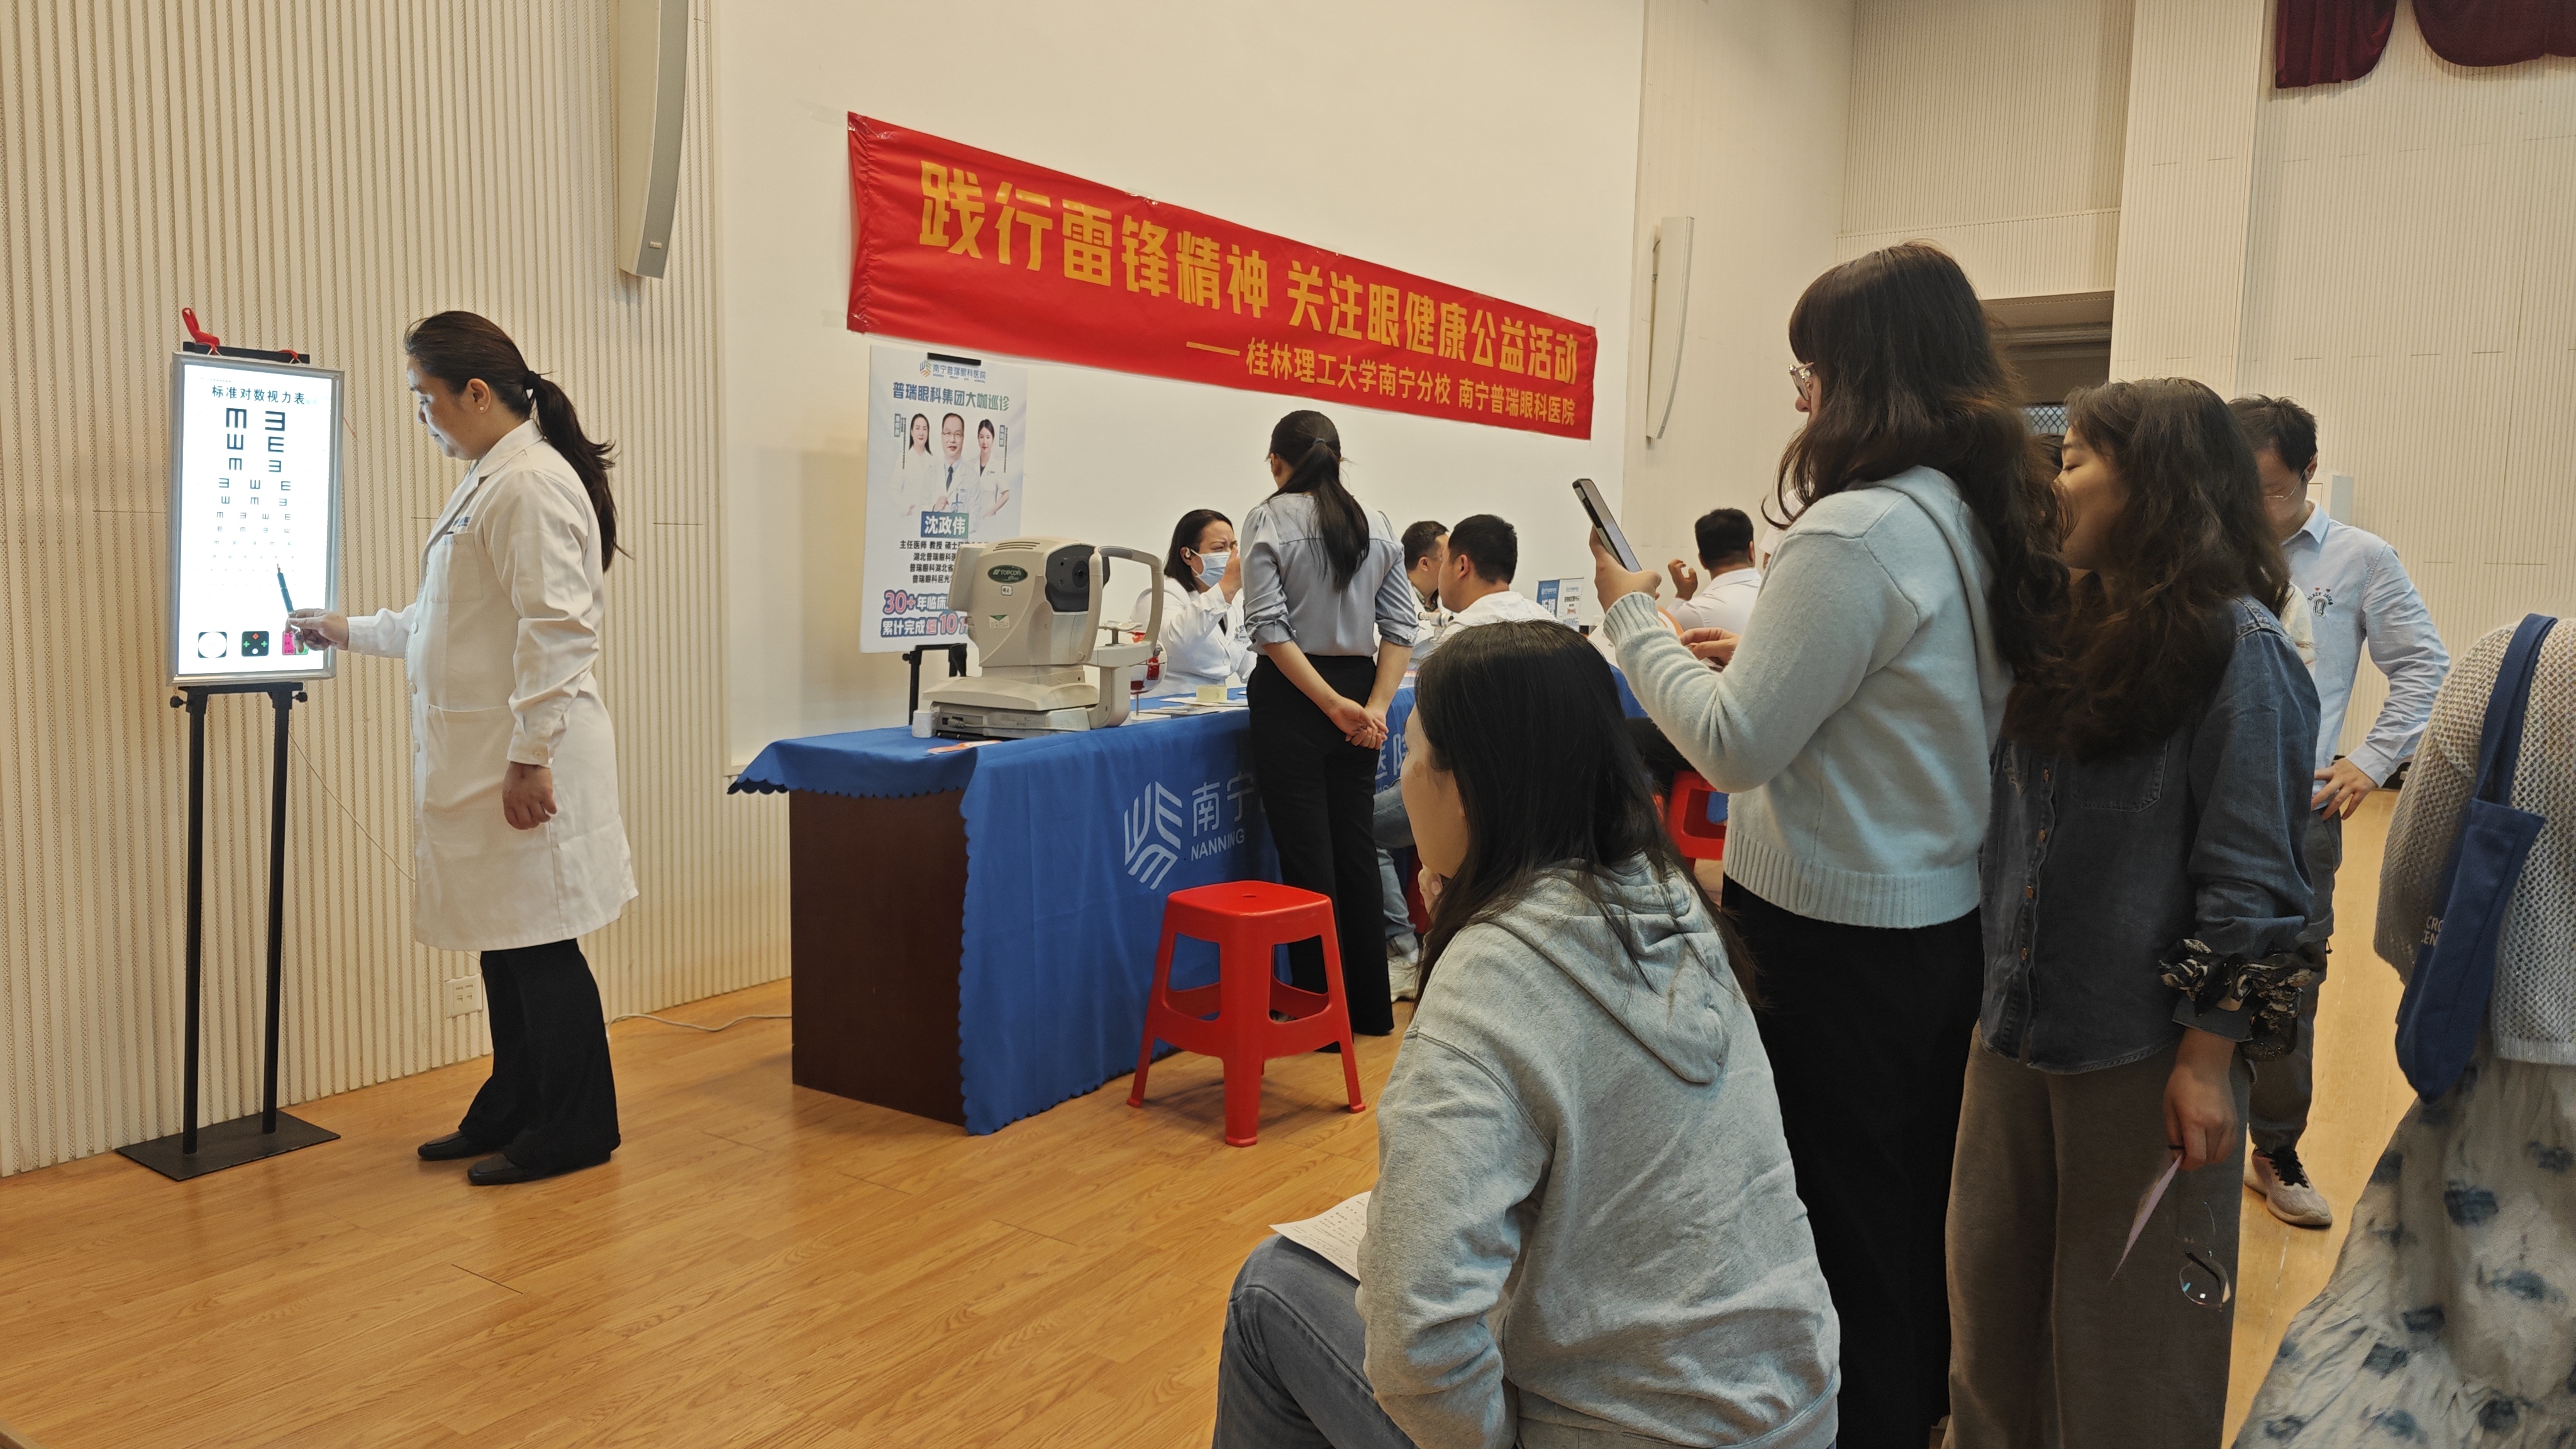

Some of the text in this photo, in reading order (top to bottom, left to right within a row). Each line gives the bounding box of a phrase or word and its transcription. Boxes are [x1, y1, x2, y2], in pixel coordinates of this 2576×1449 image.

[919, 160, 1578, 385] 践行雷锋精神 关注眼健康公益活动
[933, 364, 986, 380] 南宁普瑞眼科医院
[212, 384, 305, 405] 标准对数视力表
[892, 382, 1010, 411] 普瑞眼科集团大咖巡诊
[1458, 378, 1575, 426] 南宁普瑞眼科医院
[924, 515, 966, 535] 沈政伟
[899, 540, 927, 550] 主任医师
[930, 541, 943, 550] 教授
[913, 574, 952, 584] 普瑞眼科屈光
[884, 591, 948, 614] 30+年临床
[2307, 592, 2321, 601] BLACK
[1192, 771, 1265, 837] 南宁
[1191, 828, 1245, 862] NANNING
